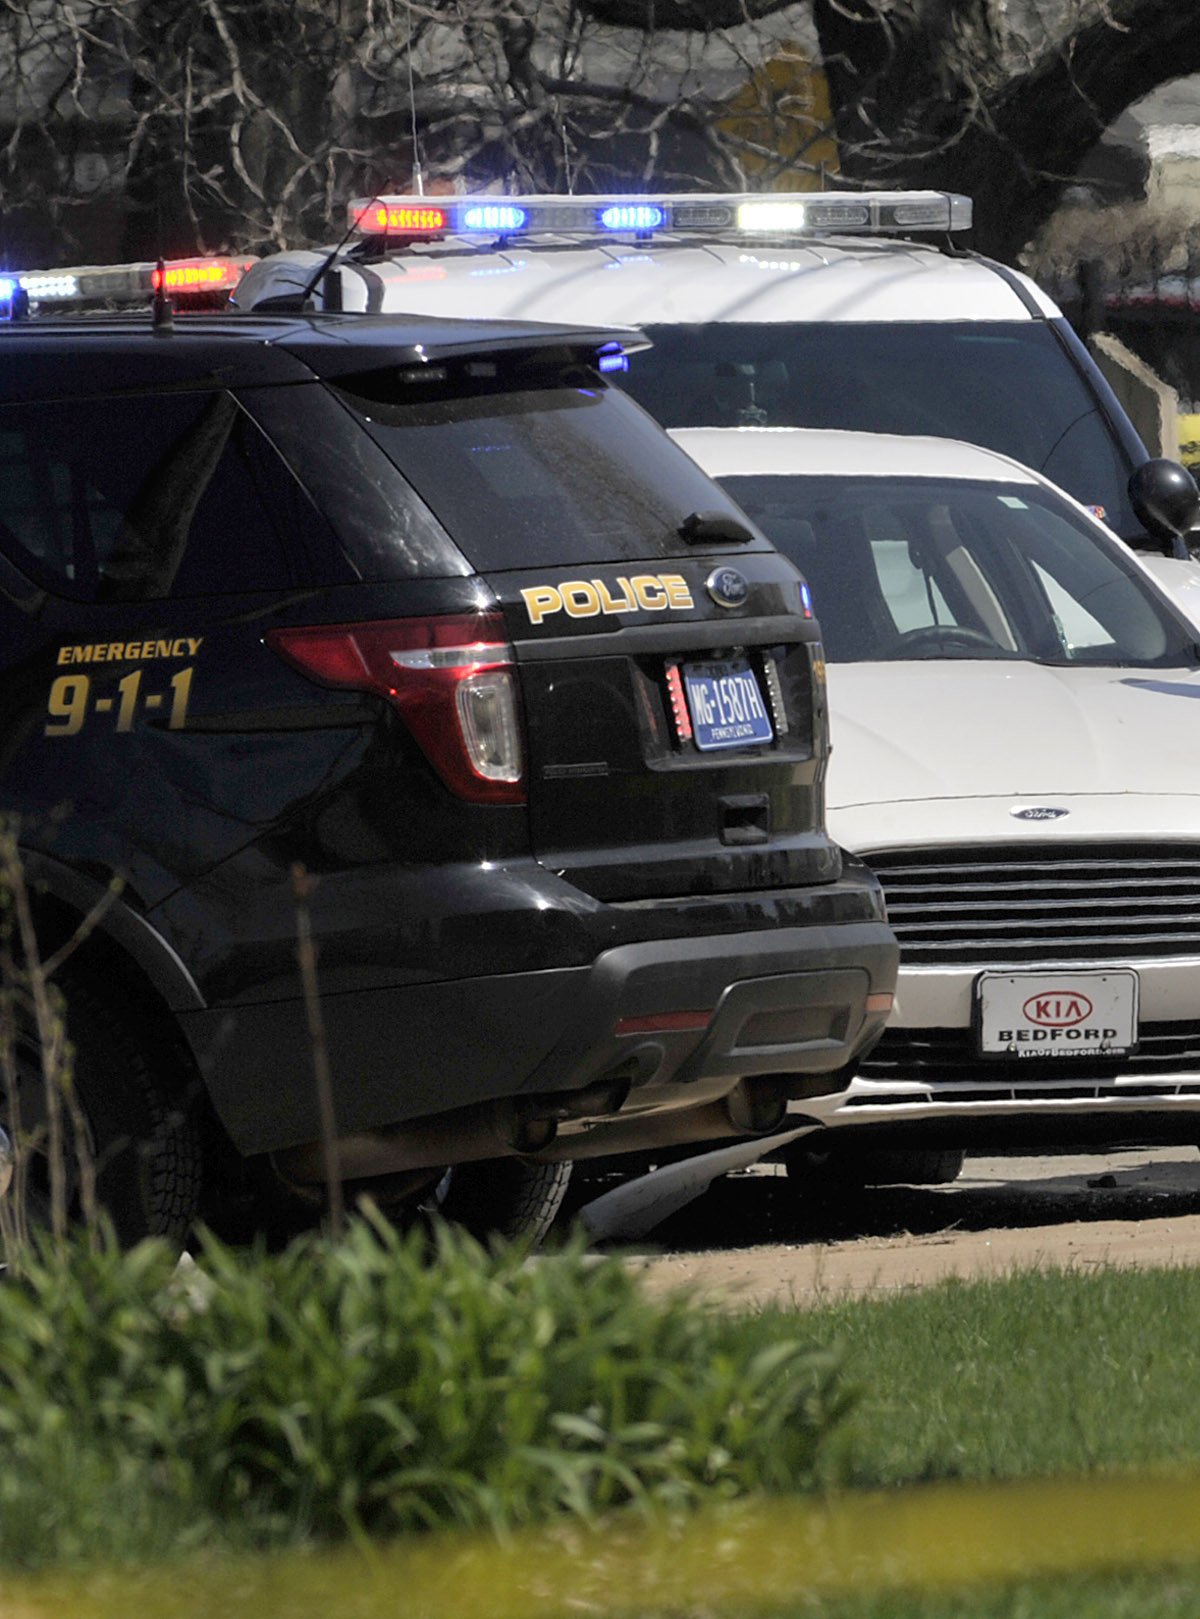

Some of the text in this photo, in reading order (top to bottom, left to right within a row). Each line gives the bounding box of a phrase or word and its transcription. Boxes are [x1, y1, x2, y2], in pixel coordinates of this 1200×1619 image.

[721, 572, 746, 596] Ford
[520, 574, 695, 624] POLICE
[57, 637, 204, 665] EMERGENCY
[44, 667, 194, 737] 9-1-1
[1035, 1000, 1082, 1019] KIA
[998, 1028, 1117, 1042] BEDFORD
